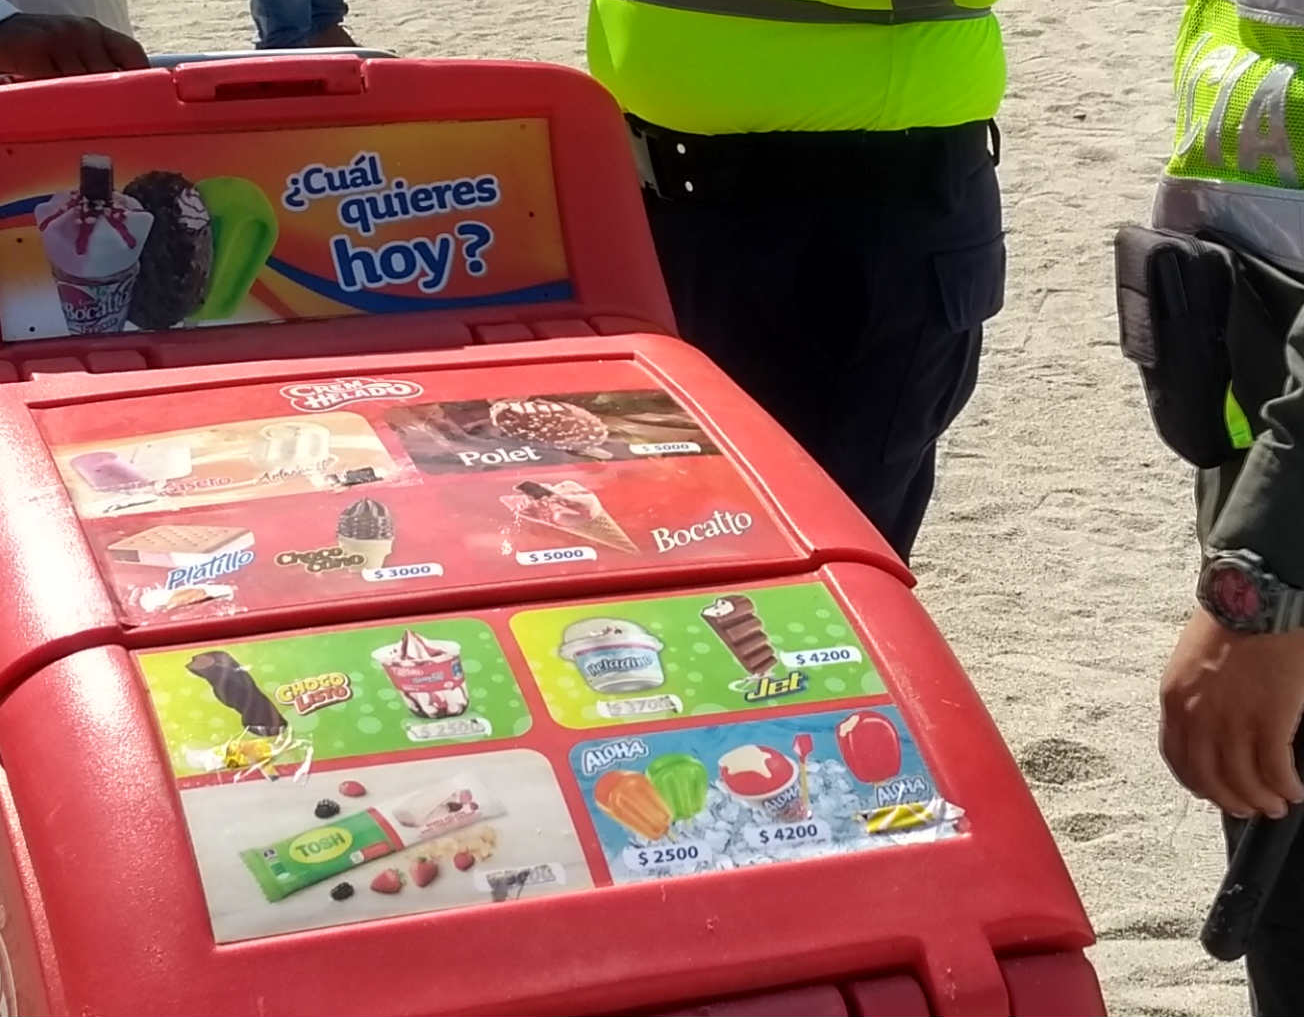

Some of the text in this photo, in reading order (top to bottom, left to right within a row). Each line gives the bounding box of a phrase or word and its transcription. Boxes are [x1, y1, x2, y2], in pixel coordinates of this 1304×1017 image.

[286, 153, 383, 207] ¿Cuál
[341, 177, 497, 234] quieres
[289, 379, 365, 396] CREM
[304, 383, 412, 409] HELADO
[457, 445, 541, 466] Polet
[654, 442, 690, 452] 5000
[650, 510, 753, 553] Bocatto
[529, 549, 584, 563] $ 5000
[167, 549, 255, 590] Platillo
[373, 565, 432, 580] $ 3000
[795, 649, 851, 665] $ 4200
[277, 672, 345, 703] CHOCO
[746, 671, 803, 700] Jet
[296, 685, 348, 713] LISTO
[584, 740, 646, 773] ALOHA
[876, 778, 927, 805] ALOHA
[295, 832, 345, 858] TOSH
[759, 824, 818, 845] $ 4200
[638, 845, 698, 866] $ 2500
